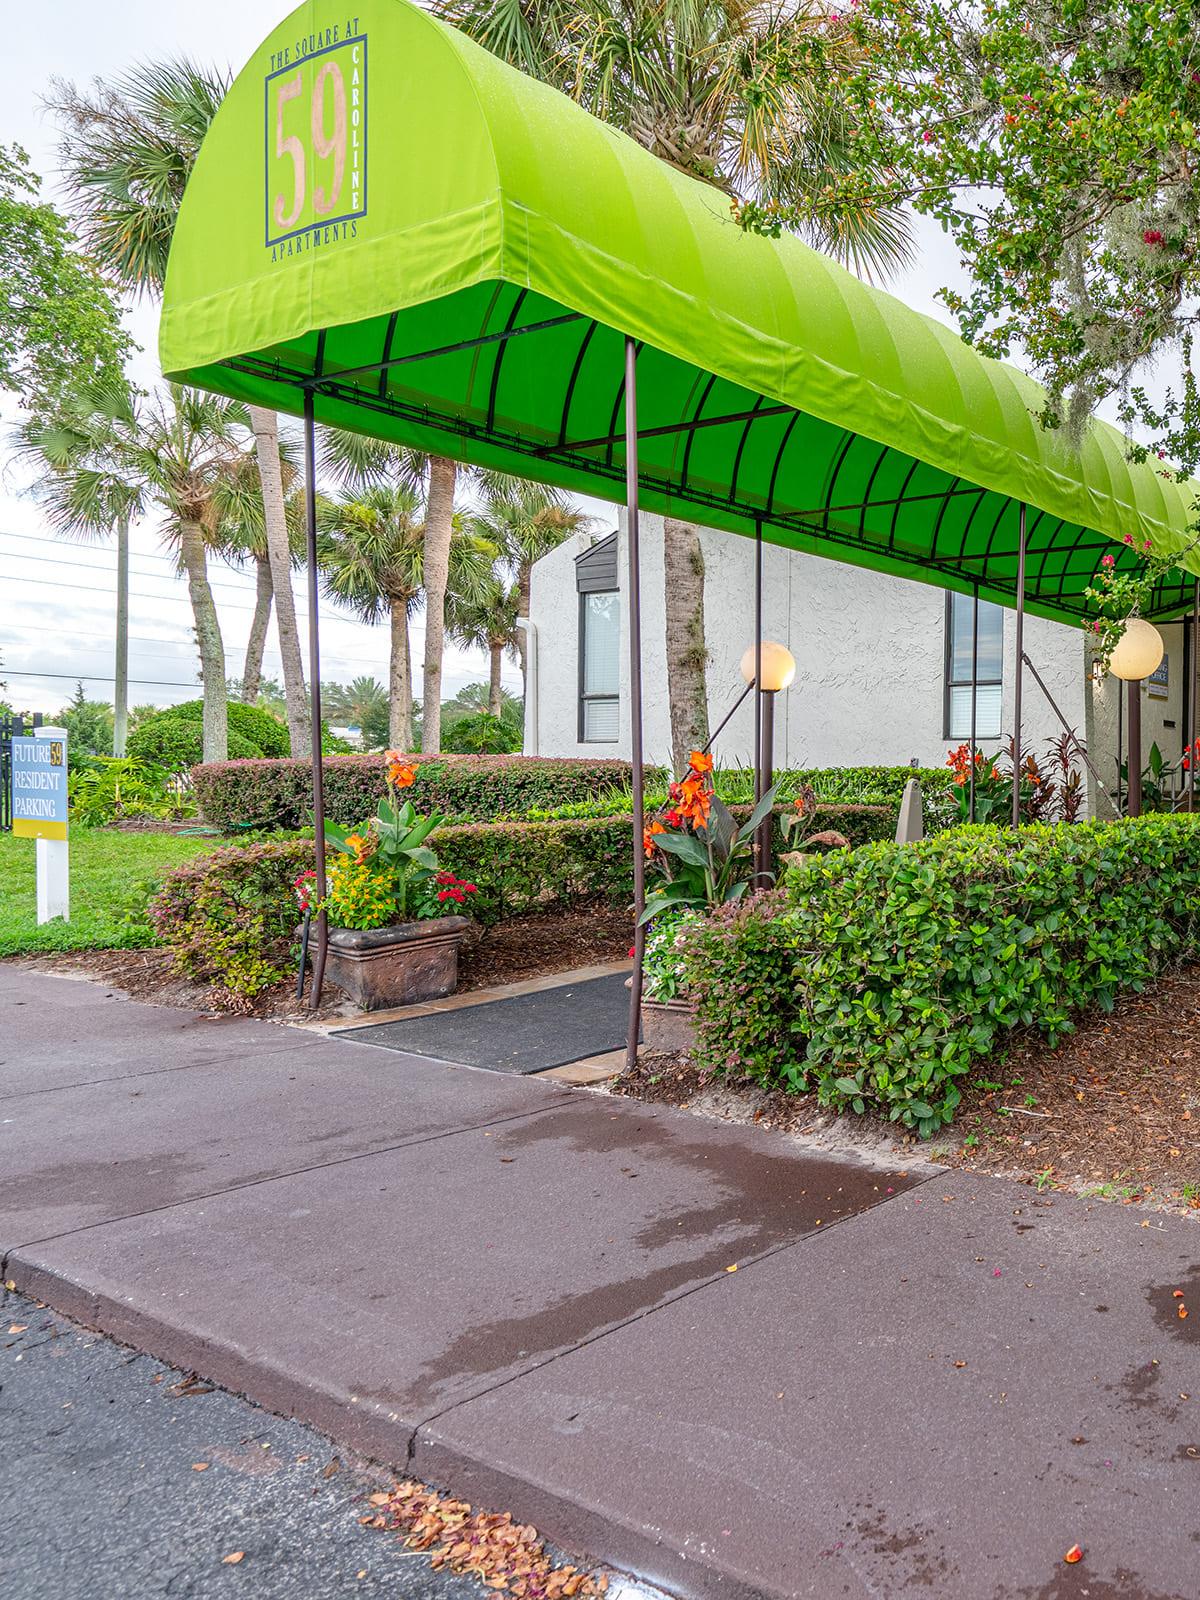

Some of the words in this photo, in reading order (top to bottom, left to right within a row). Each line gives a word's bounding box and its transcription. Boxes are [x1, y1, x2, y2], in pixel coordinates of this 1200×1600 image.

[271, 47, 289, 72] THE
[295, 25, 339, 59] SQUARE
[345, 17, 359, 38] AT
[273, 61, 346, 228] 59
[271, 220, 359, 263] APARTMENTS
[14, 744, 50, 763] FUTURE
[51, 743, 61, 765] 59
[14, 771, 60, 791] RESIDENT
[14, 797, 56, 818] PARKING
